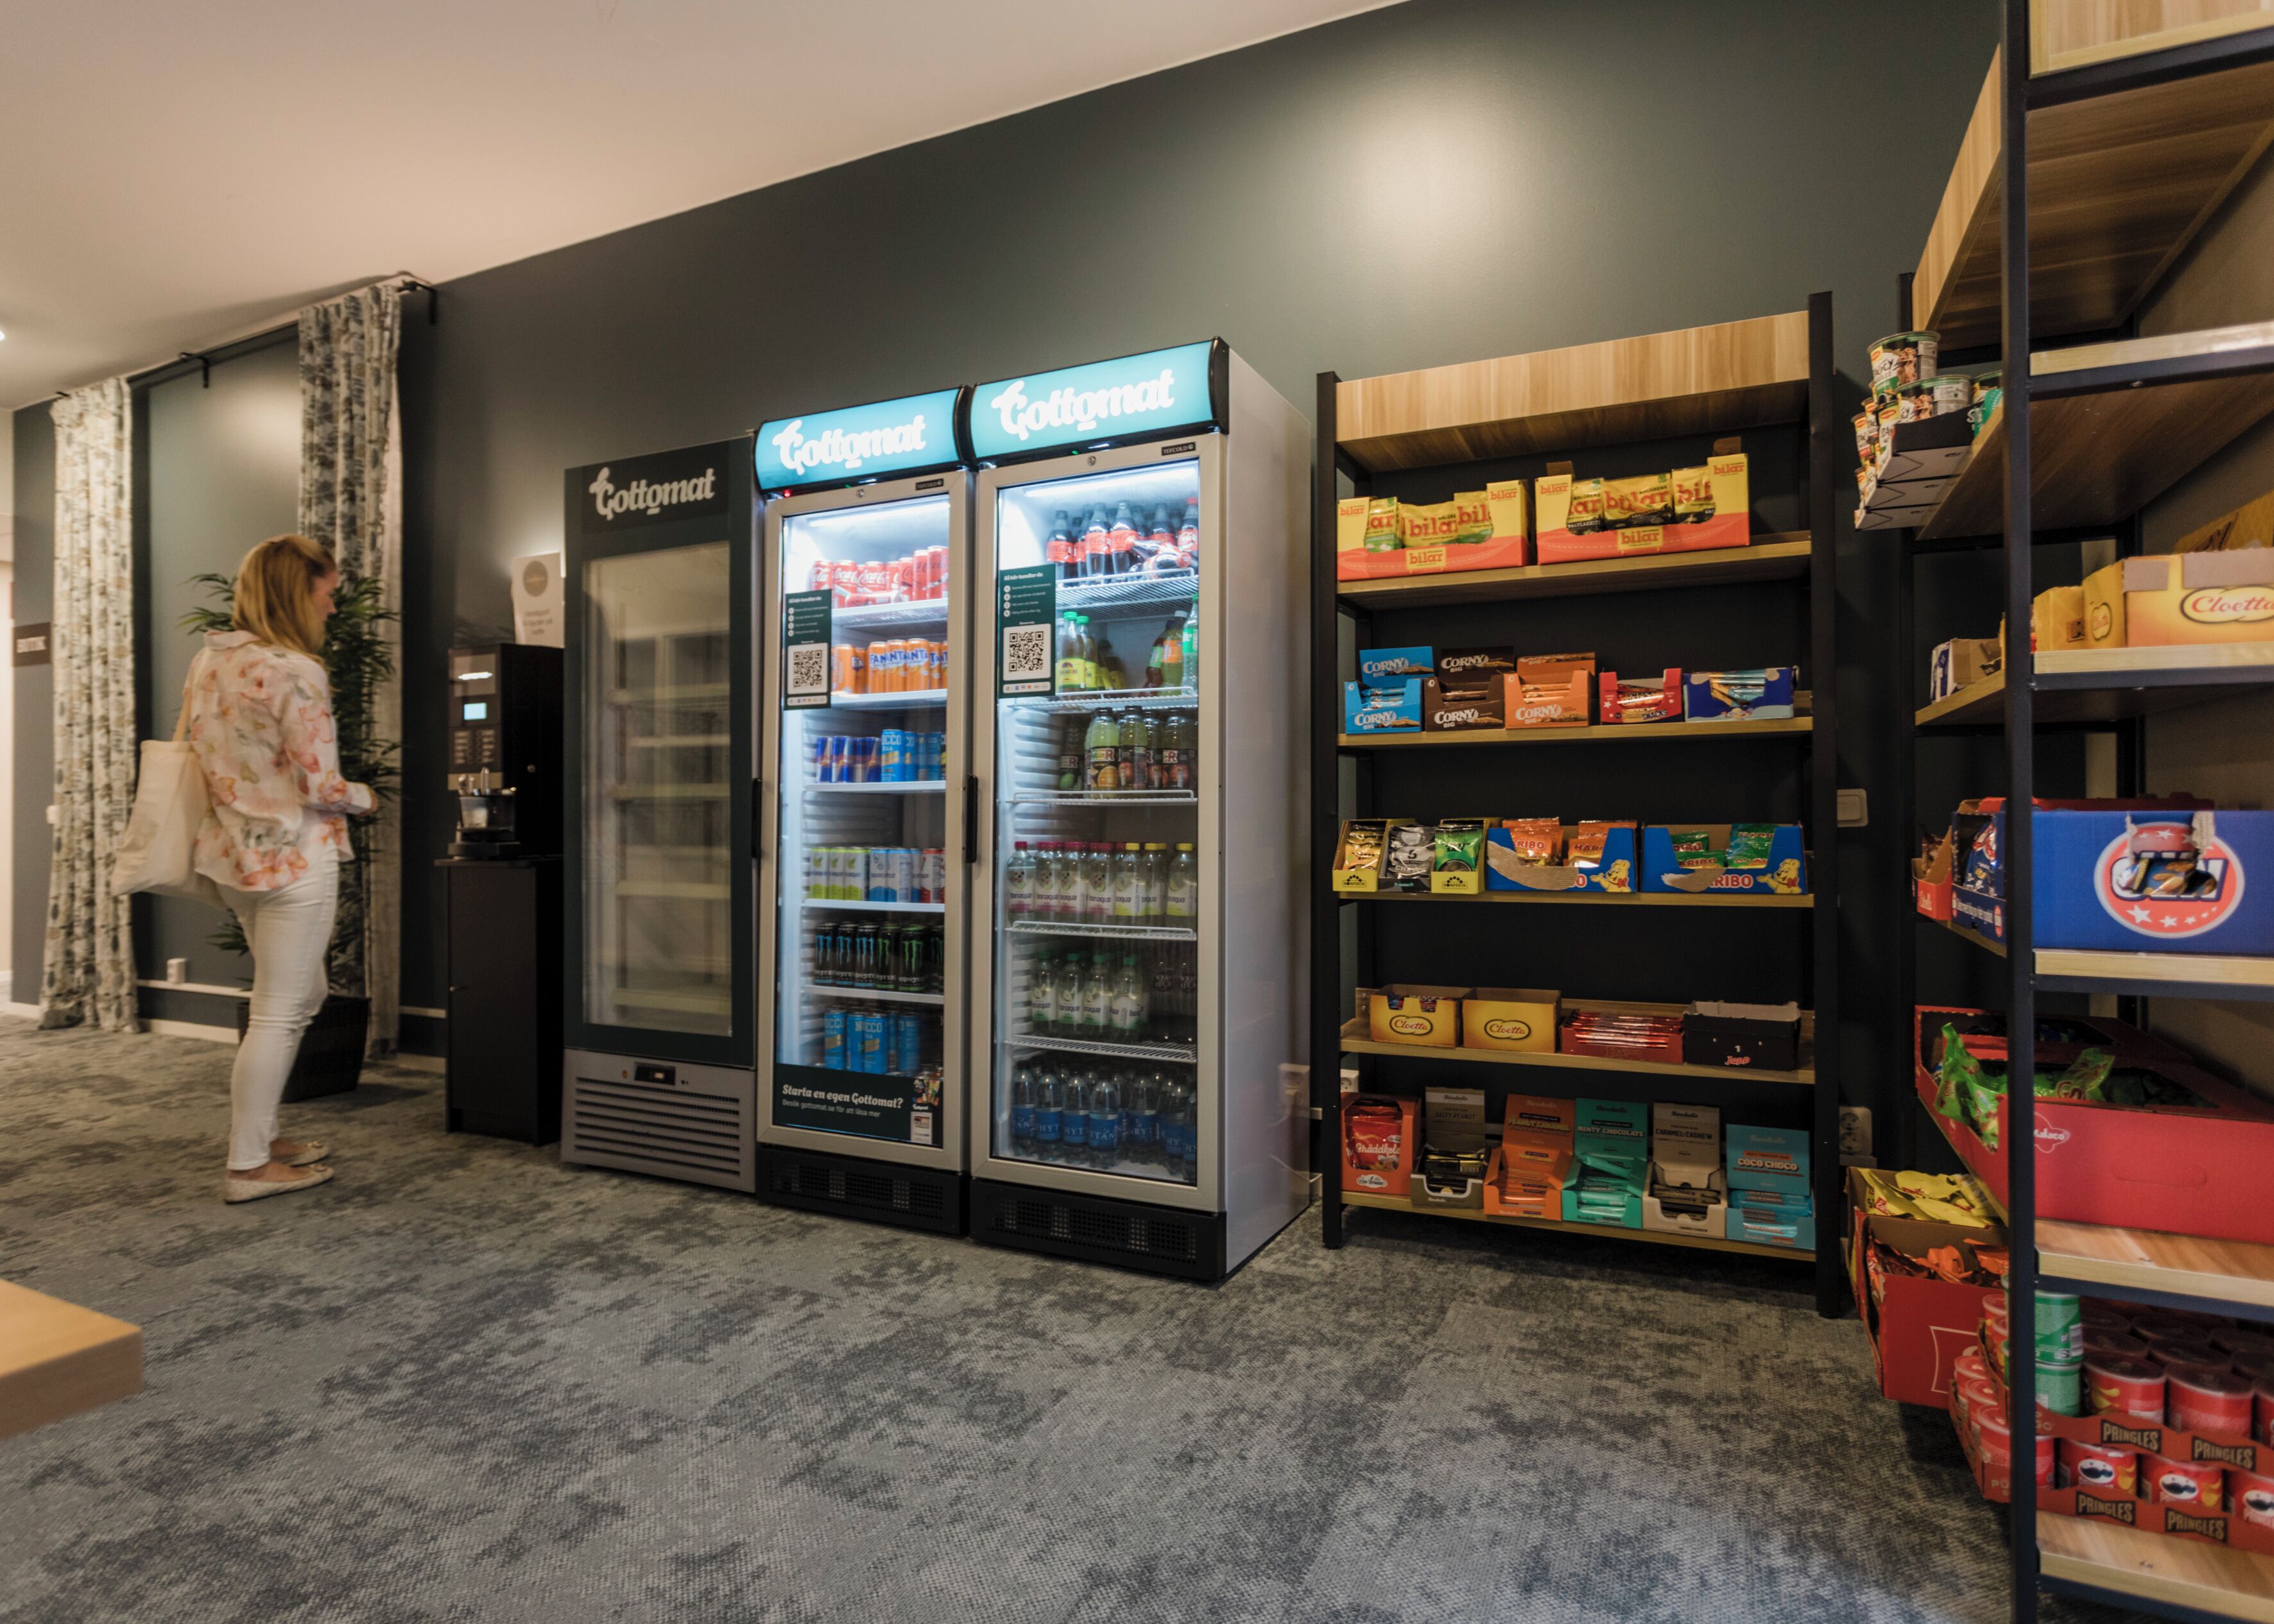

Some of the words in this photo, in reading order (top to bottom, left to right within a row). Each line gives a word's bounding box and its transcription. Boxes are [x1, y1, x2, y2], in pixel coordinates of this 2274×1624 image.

[991, 369, 1175, 440] Gottomat
[772, 415, 926, 475] Gottomat
[1162, 445, 1188, 455] TEFCOLD
[1714, 463, 1746, 475] bilar
[589, 466, 716, 521] Gottomat
[1490, 488, 1518, 500] bilar
[1540, 484, 1569, 495] bilar
[1676, 481, 1711, 504] bil
[1339, 506, 1365, 516] bilar
[1458, 504, 1490, 525] bil
[1409, 518, 1458, 538] bila
[1621, 530, 1660, 545] bilar
[1409, 550, 1443, 565] bilar
[870, 653, 886, 664] FAN
[906, 649, 928, 661] ANTA
[1441, 654, 1488, 669] CORNY
[1363, 657, 1408, 674] CORNY
[1354, 711, 1397, 726] CORNY
[1434, 708, 1479, 724] CORNY
[1515, 704, 1561, 721] CORNY
[882, 735, 901, 746] OCCO
[1162, 750, 1178, 764] ER
[1710, 875, 1753, 889] RIBO
[1393, 1018, 1429, 1031] Cloetta
[1488, 1023, 1526, 1035] Cloetta
[782, 1084, 813, 1097] Starta
[813, 1090, 825, 1100] en
[827, 1091, 850, 1104] egen
[852, 1092, 904, 1109] Gottomat?
[782, 1098, 800, 1107] Besök
[800, 1101, 835, 1112] gottomat.se
[836, 1105, 845, 1113] för
[855, 1108, 867, 1116] läsa
[868, 1110, 881, 1118] mer
[1602, 1128, 1644, 1138] CHOCOLATE
[1737, 1157, 1764, 1168] COCO
[1764, 1160, 1798, 1172] CHOCO
[2103, 1422, 2160, 1452] PRINGLES
[2194, 1439, 2253, 1469] PRINGLES
[2078, 1494, 2133, 1524] PRINGLES
[2167, 1510, 2226, 1541] PRINGLES
